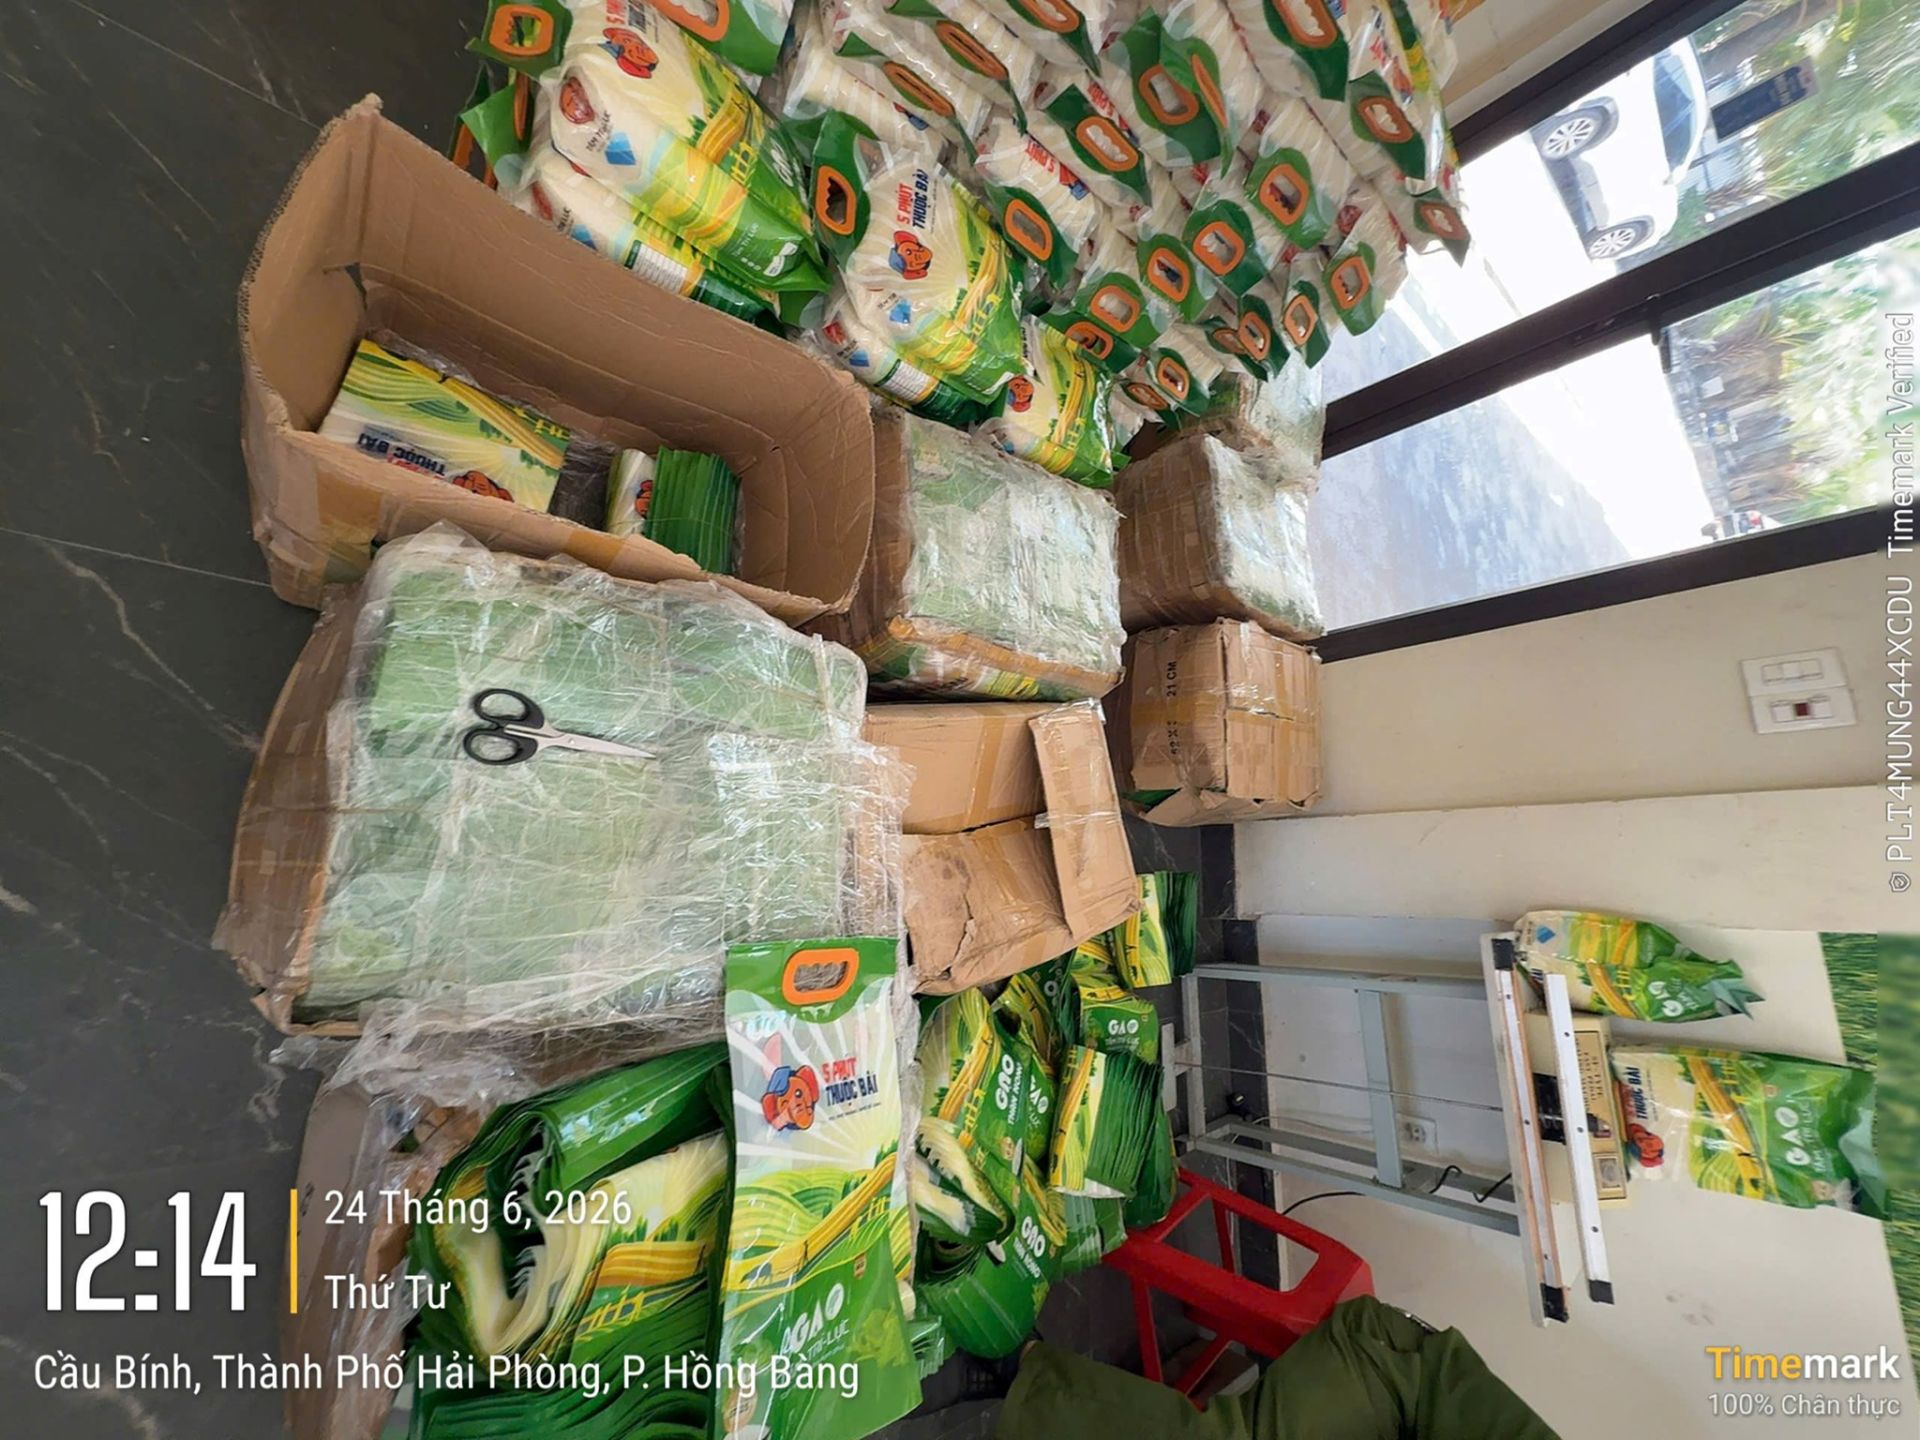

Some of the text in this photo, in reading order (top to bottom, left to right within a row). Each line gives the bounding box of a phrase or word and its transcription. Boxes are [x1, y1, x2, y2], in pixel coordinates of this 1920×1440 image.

[911, 192, 932, 229] THUỘC
[1166, 660, 1178, 697] 21 CM
[825, 1077, 859, 1107] THUỘC
